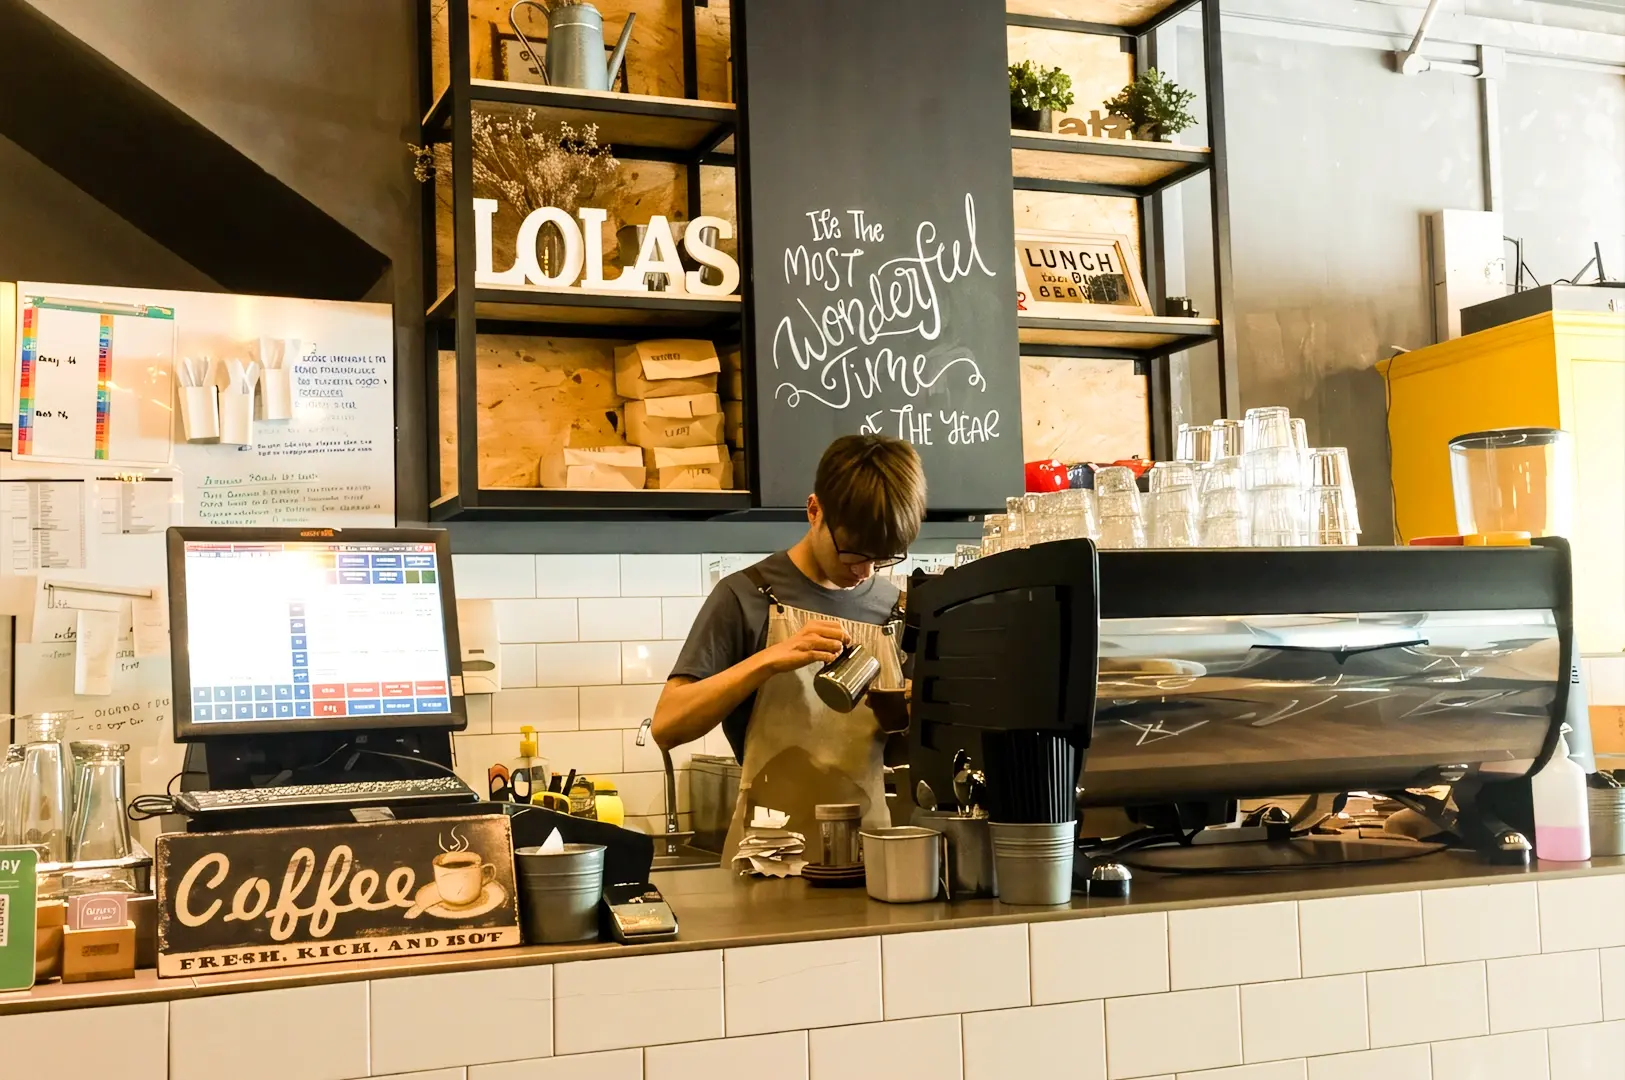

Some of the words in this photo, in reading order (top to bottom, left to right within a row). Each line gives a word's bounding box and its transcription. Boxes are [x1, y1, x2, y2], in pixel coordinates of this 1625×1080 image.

[473, 197, 740, 297] LOLAS
[847, 210, 885, 243] The
[773, 192, 997, 370] Wonderful
[784, 245, 864, 292] MOST
[1025, 248, 1114, 273] LUNCH
[775, 346, 987, 409] Time
[889, 404, 933, 445] THE
[940, 410, 1000, 445] YEAR
[175, 844, 416, 941] Coffee
[388, 937, 439, 951] AND
